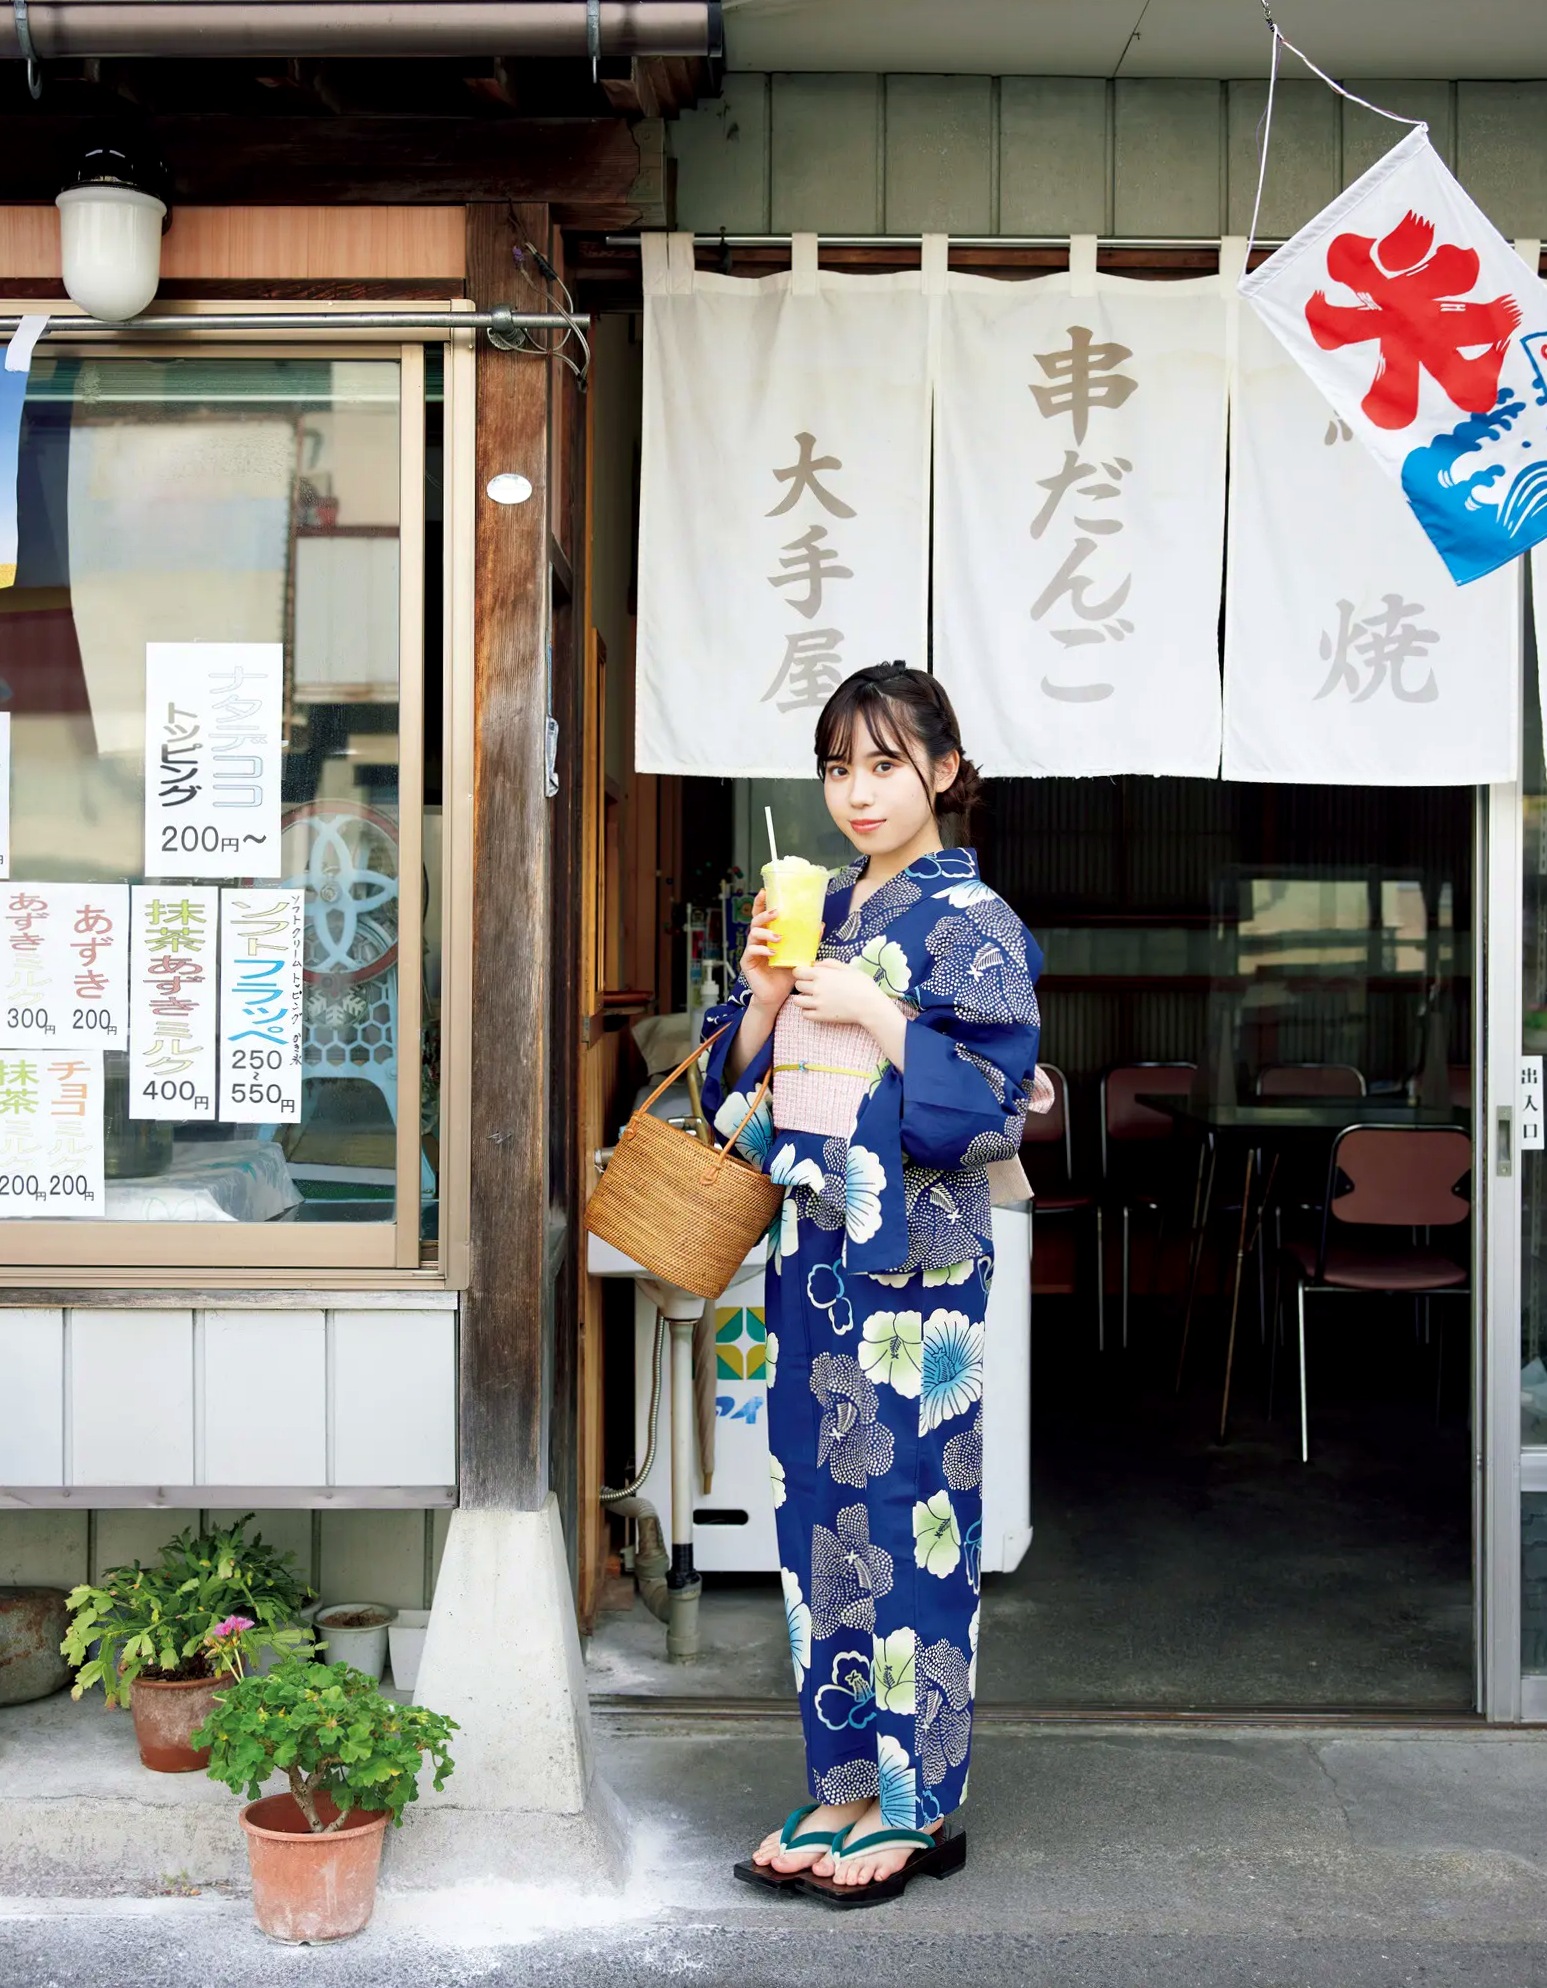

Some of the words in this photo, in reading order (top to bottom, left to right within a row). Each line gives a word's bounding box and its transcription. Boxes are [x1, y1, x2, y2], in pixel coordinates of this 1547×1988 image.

[1304, 209, 1522, 431] 氷
[1027, 325, 1139, 704] 串だんご
[760, 432, 858, 714] 大手屋
[158, 702, 203, 807] トッピング
[208, 665, 268, 808] ナタデココ
[5, 892, 53, 1008] あずきミルク
[70, 904, 114, 999] あずき
[142, 898, 207, 1076] 抹茶あずきミルク
[227, 901, 290, 1046] ソフトフラッペ
[7, 1008, 55, 1035] 300円
[72, 1009, 117, 1035] 200円
[47, 1060, 94, 1175] チョコミルク
[143, 1080, 209, 1110] 400円
[231, 1083, 295, 1113] 550円
[1521, 1068, 1538, 1139] 出入口
[49, 1175, 94, 1201] 200円
